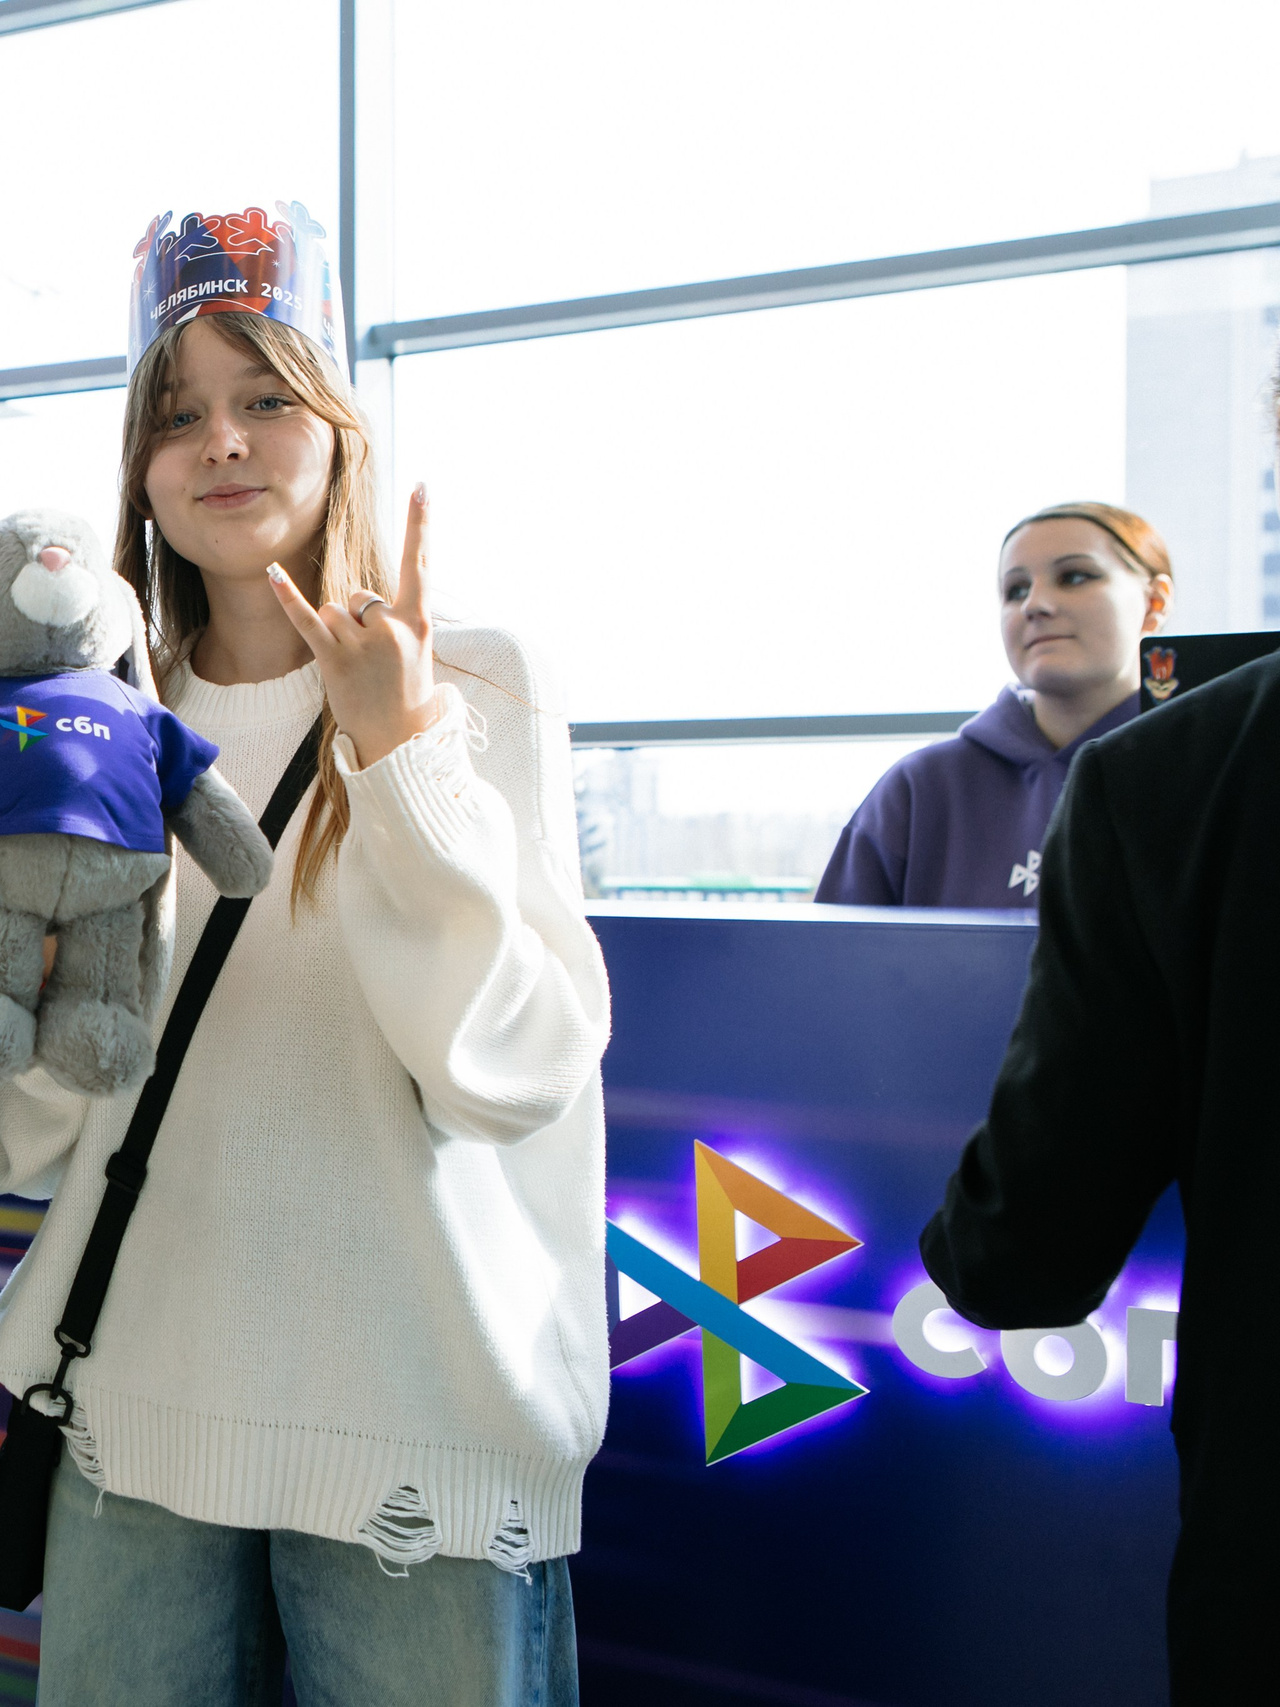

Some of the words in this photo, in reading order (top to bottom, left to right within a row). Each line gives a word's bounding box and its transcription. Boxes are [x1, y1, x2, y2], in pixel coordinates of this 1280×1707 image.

[150, 278, 249, 321] ЧЕЛЯБИНСК
[260, 282, 303, 311] 2025
[55, 715, 111, 741] сбп
